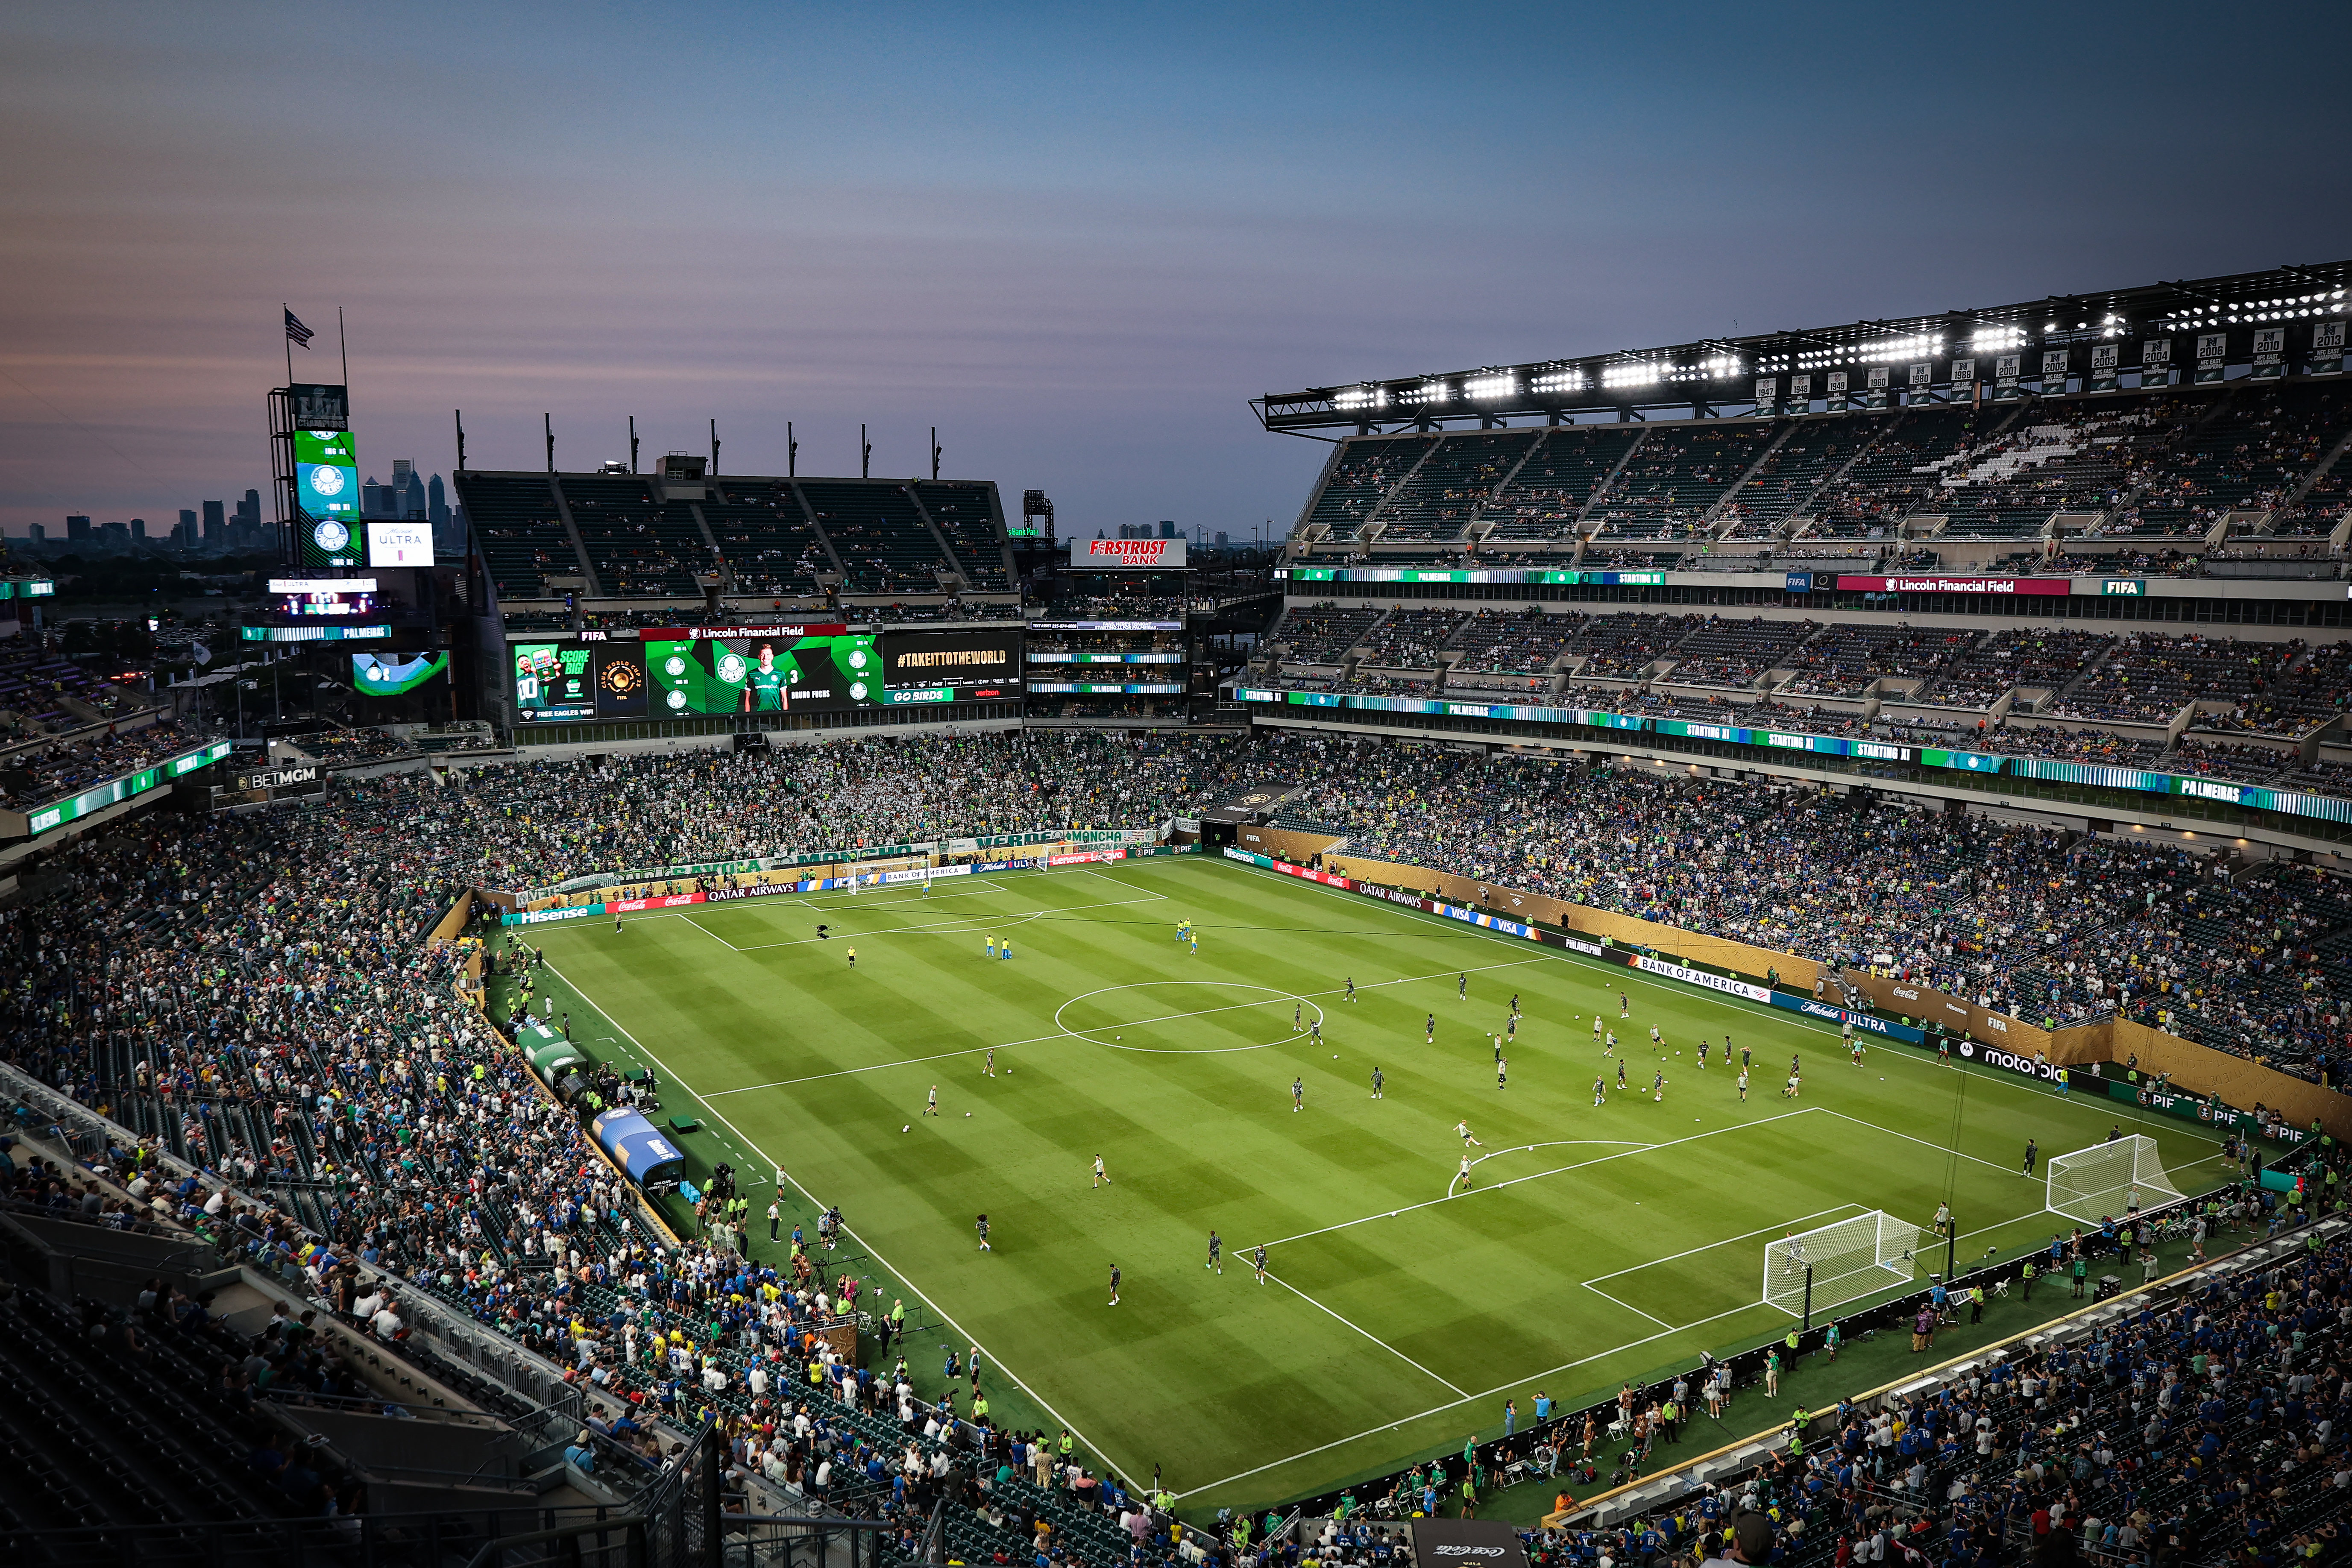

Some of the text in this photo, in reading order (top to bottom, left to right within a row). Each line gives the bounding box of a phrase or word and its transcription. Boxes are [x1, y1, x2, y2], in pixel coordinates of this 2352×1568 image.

[2257, 341, 2279, 352] 2010
[2317, 335, 2341, 346] 2013
[2145, 352, 2167, 362] 2004
[2200, 346, 2223, 357] 2006
[2045, 362, 2065, 372] 2002
[2094, 357, 2115, 367] 2003
[1954, 370, 1971, 379] 1988
[1999, 366, 2017, 376] 2001
[1870, 378, 1886, 387] 1960
[1912, 374, 1928, 383] 1980
[1758, 388, 1774, 396] 1947
[1830, 382, 1845, 390] 1949
[298, 419, 346, 428] CHAMPIONS
[1012, 527, 1025, 536] Bank
[1026, 527, 1039, 536] Park
[379, 536, 422, 544] ULTRA
[1122, 555, 1158, 565] BANK
[1418, 573, 1451, 581] PALMEIRAS
[1619, 574, 1660, 583] STARTING XI
[1900, 580, 2014, 593] Lincoln Financial Field
[2107, 582, 2137, 594] FIFA
[343, 627, 385, 638] PALMEIRAS
[581, 631, 607, 641] FIFA
[703, 626, 804, 638] Lincoln Financial Field
[560, 650, 590, 663] SCORE
[897, 651, 1006, 668] #TAKEITTOTHEWORLD
[565, 662, 585, 675] BIG!
[606, 660, 629, 670] WORLD
[631, 665, 641, 677] CUP
[636, 679, 641, 687] 25
[720, 666, 744, 681] PALMEIRAS
[790, 670, 798, 683] 3
[791, 690, 830, 699] BRUNO FUCHS
[894, 690, 943, 702] GO BIRDS
[1246, 691, 1281, 702] STARTING XI
[1449, 704, 1489, 717] PALMEIRAS
[1686, 724, 1730, 740] STARTING XI
[1768, 733, 1814, 750] STARTING XI
[1857, 743, 1910, 761] STARTING XI
[252, 767, 316, 788] BETMGM
[2182, 780, 2240, 803] PALMEIRAS
[1073, 830, 1144, 842] MANCHA USA
[1246, 834, 1260, 842] FIFA
[1053, 855, 1085, 865] Lenovo
[1223, 846, 1255, 864] Hisense
[924, 868, 959, 876] AMERICA
[978, 862, 1007, 872] Michelob
[1277, 862, 1293, 874] Coca-Cola
[1302, 869, 1317, 880] Coca-Cola
[1328, 875, 1343, 887] Coca-Cola
[709, 883, 794, 902] QATAR AIRWAYS
[1359, 883, 1422, 908] QATAR AIRWAYS
[618, 900, 647, 911] Coca-Cola
[665, 894, 692, 906] Coca-Cola
[522, 907, 588, 924] Hisense
[1450, 906, 1470, 921] VISA
[1497, 918, 1518, 935] VISA
[1566, 938, 1602, 957] PHILADELPHIA
[1643, 958, 1748, 995] BANK OF AMERICA
[1893, 987, 1919, 1000] Coca-Cola
[1946, 1002, 1967, 1015] Hisense
[1801, 1001, 1887, 1033] Michelob ULTRA
[1987, 1017, 2007, 1033] FIFA
[2153, 1094, 2175, 1109] PIF
[2214, 1111, 2237, 1125] PIF
[2279, 1126, 2303, 1143] PIF
[1922, 1430, 1930, 1439] 19
[1706, 1504, 1713, 1512] 6
[1805, 1504, 1812, 1512] 8
[1433, 1545, 1505, 1558] Coca-Cola
